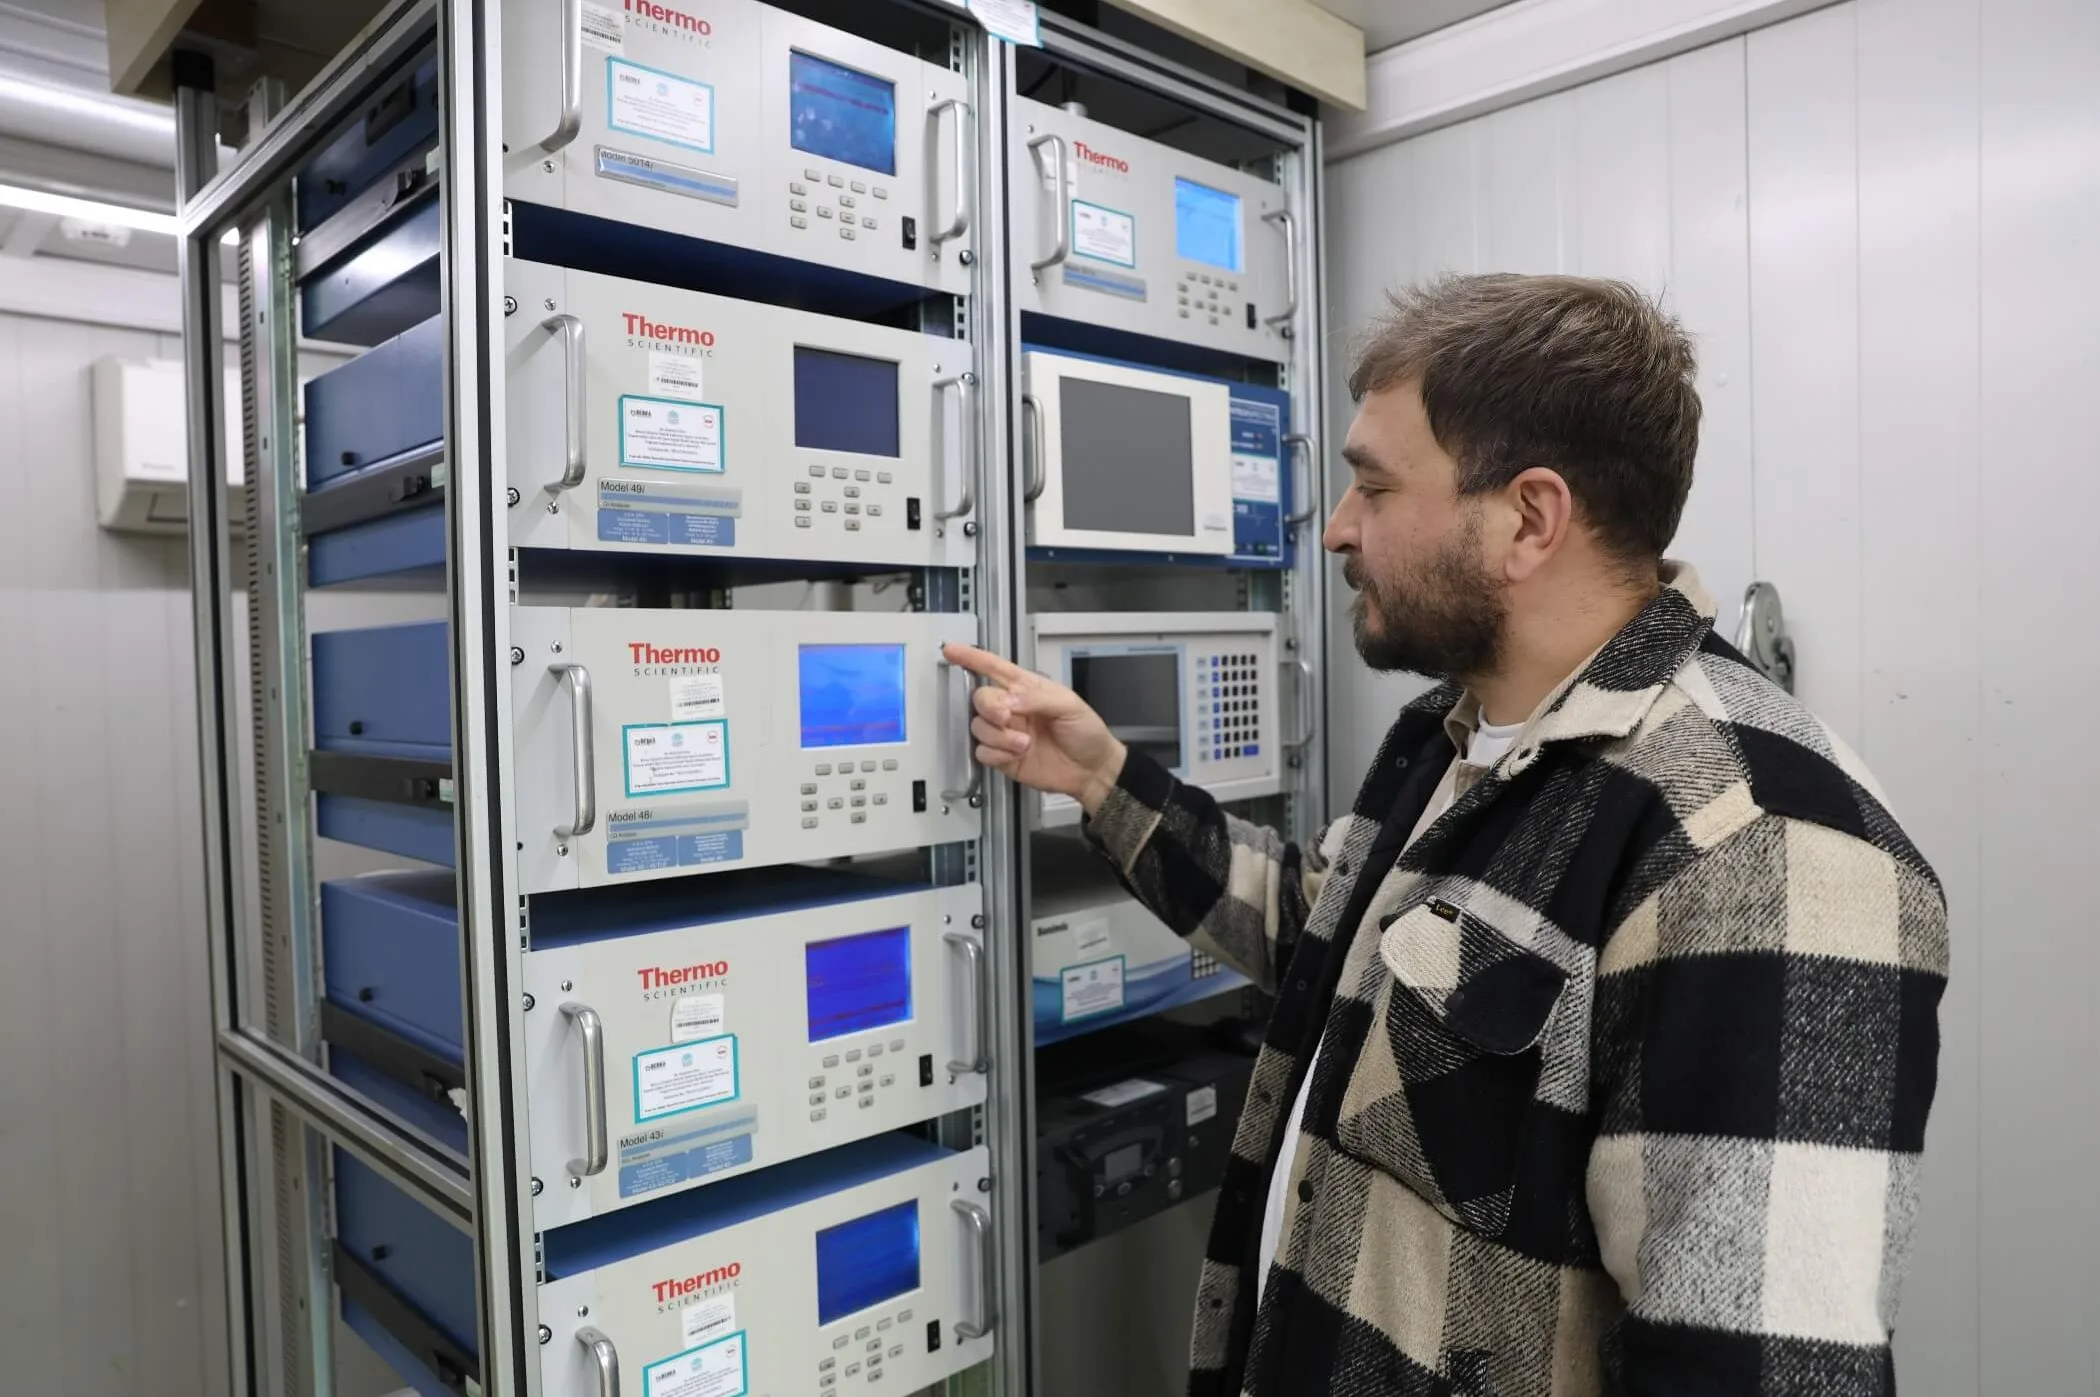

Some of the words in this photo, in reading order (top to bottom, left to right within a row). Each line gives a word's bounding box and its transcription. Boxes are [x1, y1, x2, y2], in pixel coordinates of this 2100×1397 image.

[625, 15, 712, 50] SCIENTIFIC
[1073, 141, 1129, 173] Thermo
[622, 312, 715, 347] Thermo
[628, 339, 713, 358] SCIENTIFIC
[601, 481, 629, 493] Model
[631, 484, 645, 494] 49i
[628, 643, 721, 664] Thermo
[634, 666, 720, 677] SCIENTIFIC
[608, 811, 637, 823] Model
[638, 811, 654, 820] 48i
[637, 960, 729, 990] Thermo
[643, 979, 728, 1001] SCIENTIFIC
[620, 1133, 647, 1149] Model
[649, 1130, 664, 1141] 43i
[652, 1262, 741, 1303] Thermo
[658, 1279, 741, 1314] SCIENTIFIC
